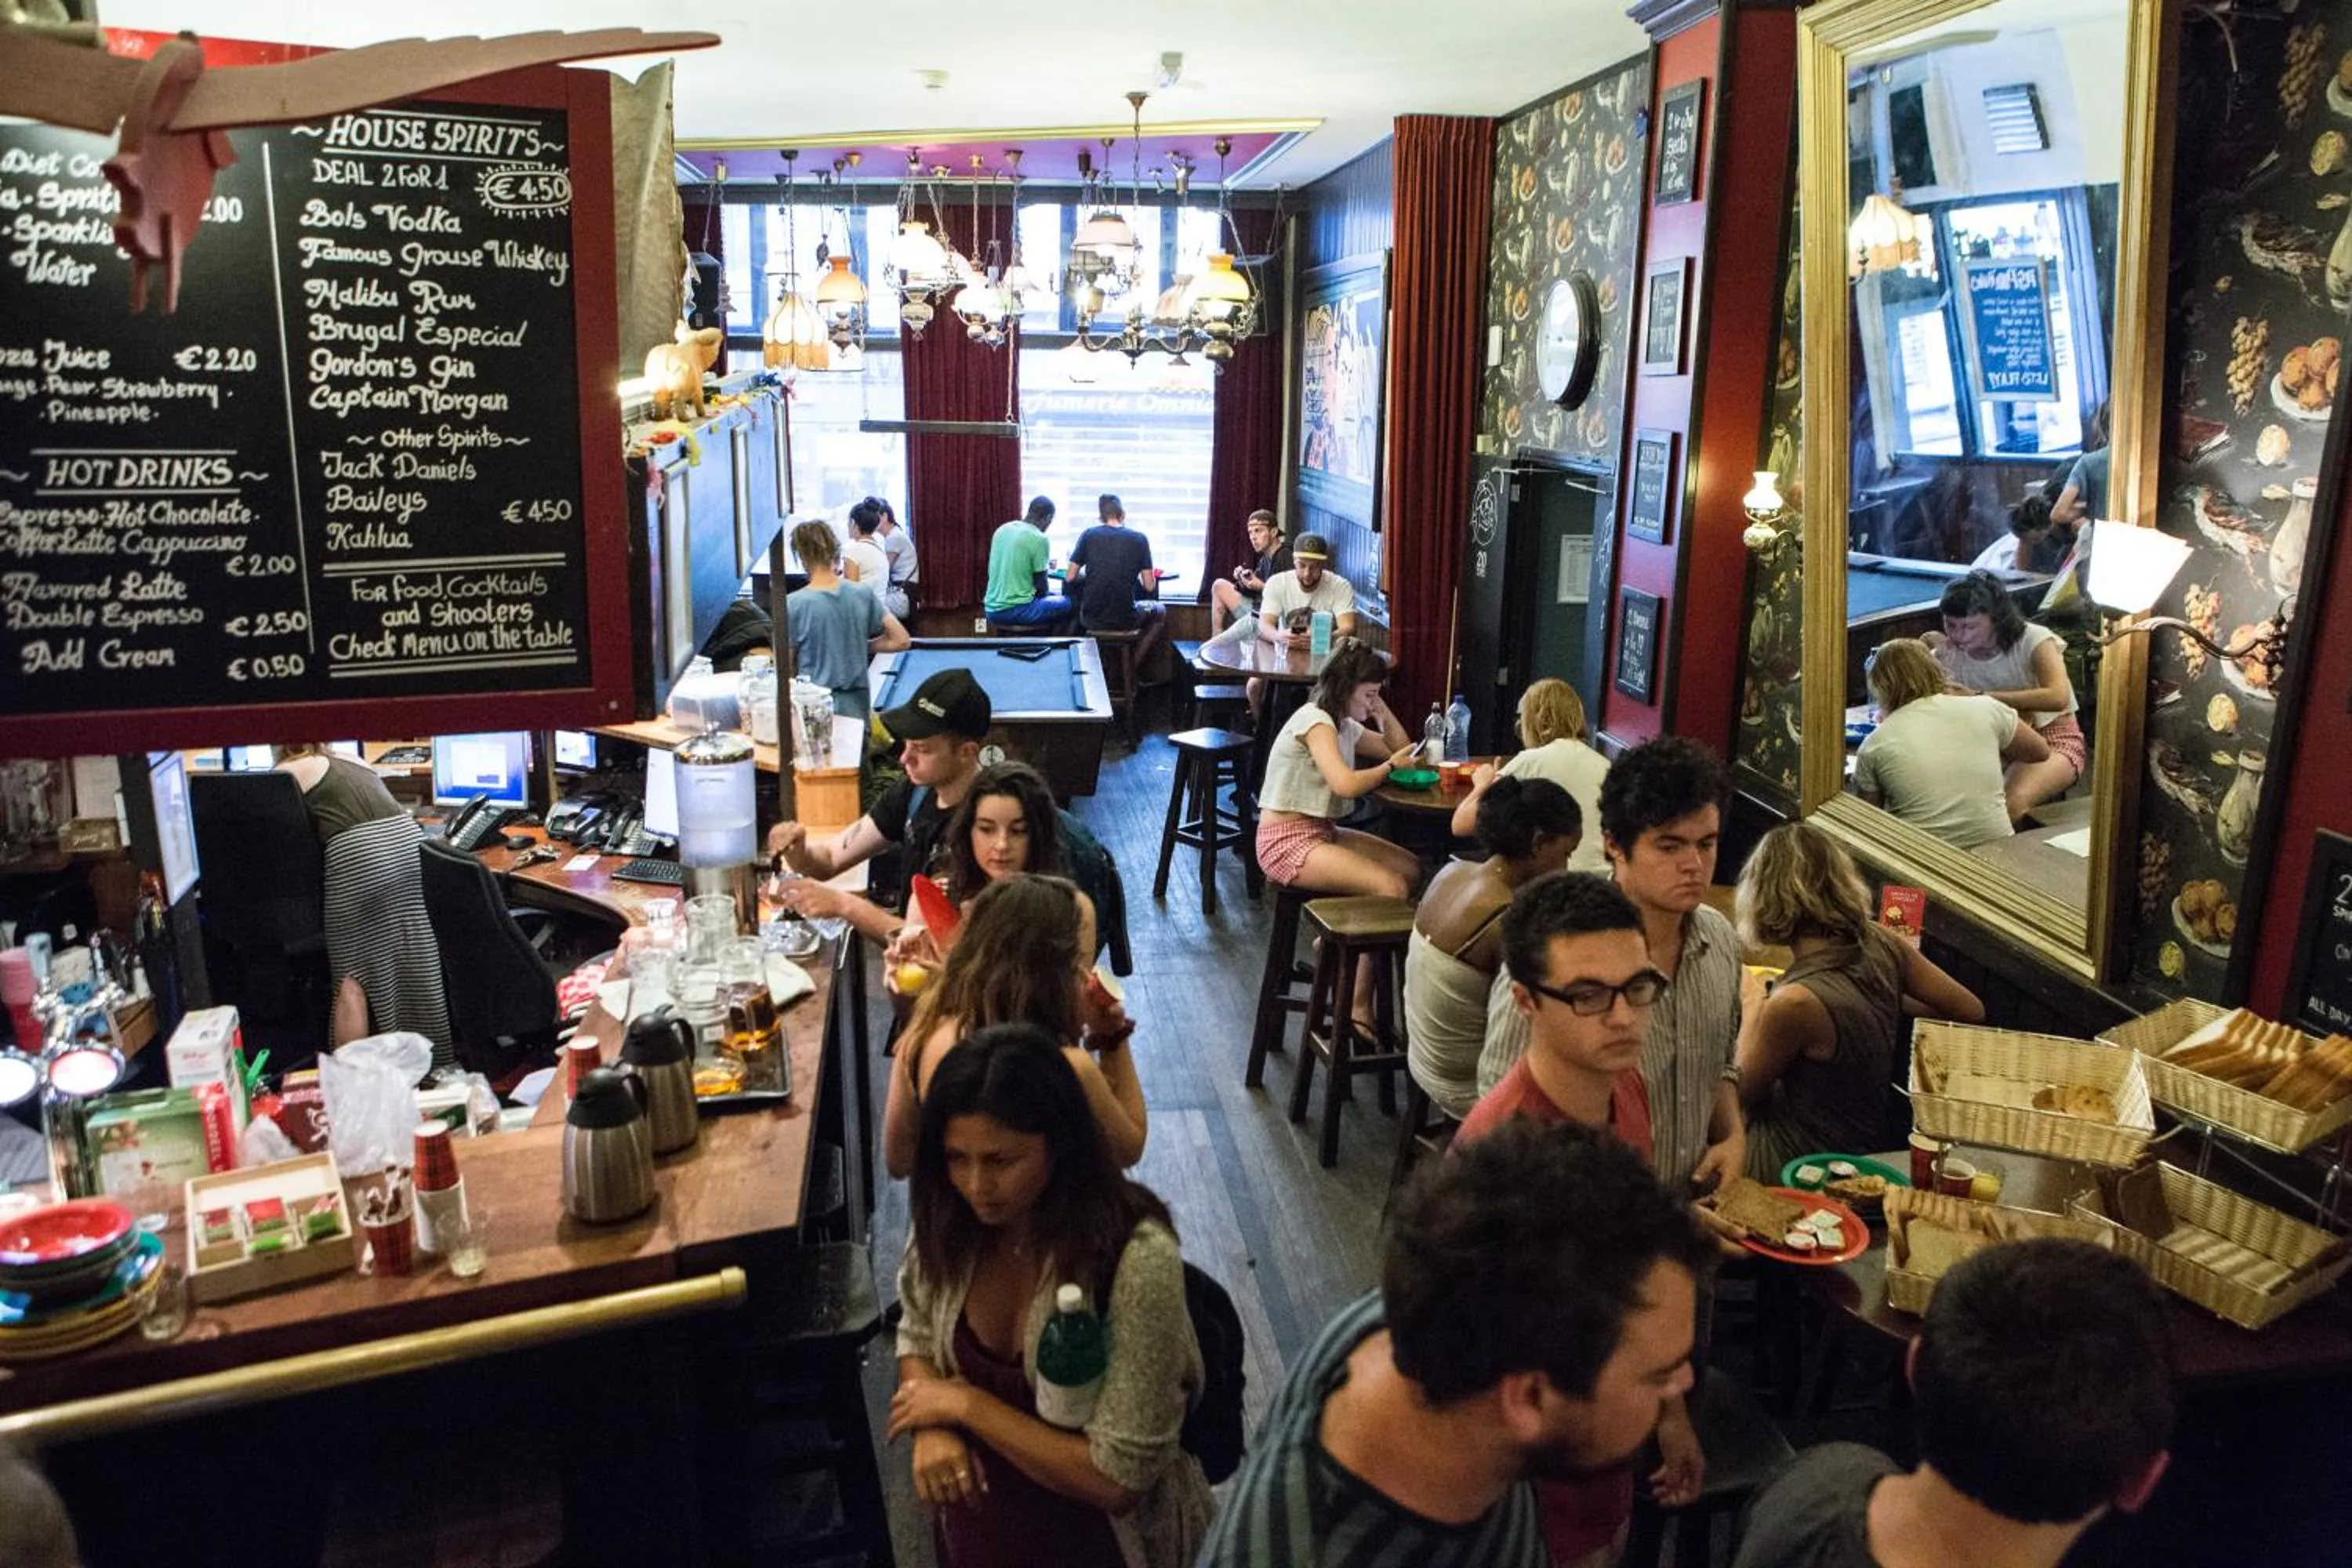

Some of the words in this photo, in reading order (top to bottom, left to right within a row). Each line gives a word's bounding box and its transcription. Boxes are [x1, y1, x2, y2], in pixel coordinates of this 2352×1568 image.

[325, 115, 427, 150] HOUSE
[431, 124, 540, 156] SPIRITS
[0, 148, 60, 176] Diet
[314, 158, 375, 186] DEAL
[381, 164, 396, 187] 2
[434, 165, 449, 190] 1
[299, 199, 366, 230] Bols
[372, 204, 463, 234] Vodka
[9, 249, 98, 287] Water
[299, 237, 391, 269] Famous
[483, 240, 571, 287] Whiskey
[304, 278, 399, 310] Malibu
[308, 313, 405, 353] Brugal
[415, 317, 528, 352] Especial
[42, 338, 111, 374] Juice
[101, 376, 220, 409] Strawberry
[309, 381, 412, 419] Captain
[407, 384, 510, 420] Morgan
[46, 399, 152, 424] Pineapple
[380, 428, 435, 448] Other
[437, 423, 503, 456] Spirits
[44, 459, 114, 486] HOT
[114, 457, 234, 487] DRINKS
[391, 452, 477, 481] Daniels
[103, 500, 147, 528] Hot
[149, 499, 252, 524] Chocolate
[325, 485, 428, 524] Baileys
[325, 523, 414, 550] Kahlua
[118, 572, 188, 601] Latte
[6, 602, 95, 630] Double
[100, 601, 205, 634] Espresso
[381, 601, 420, 627] and
[430, 597, 534, 627] Shooters
[490, 624, 523, 650] the
[522, 619, 574, 648] table
[21, 637, 85, 674] Add
